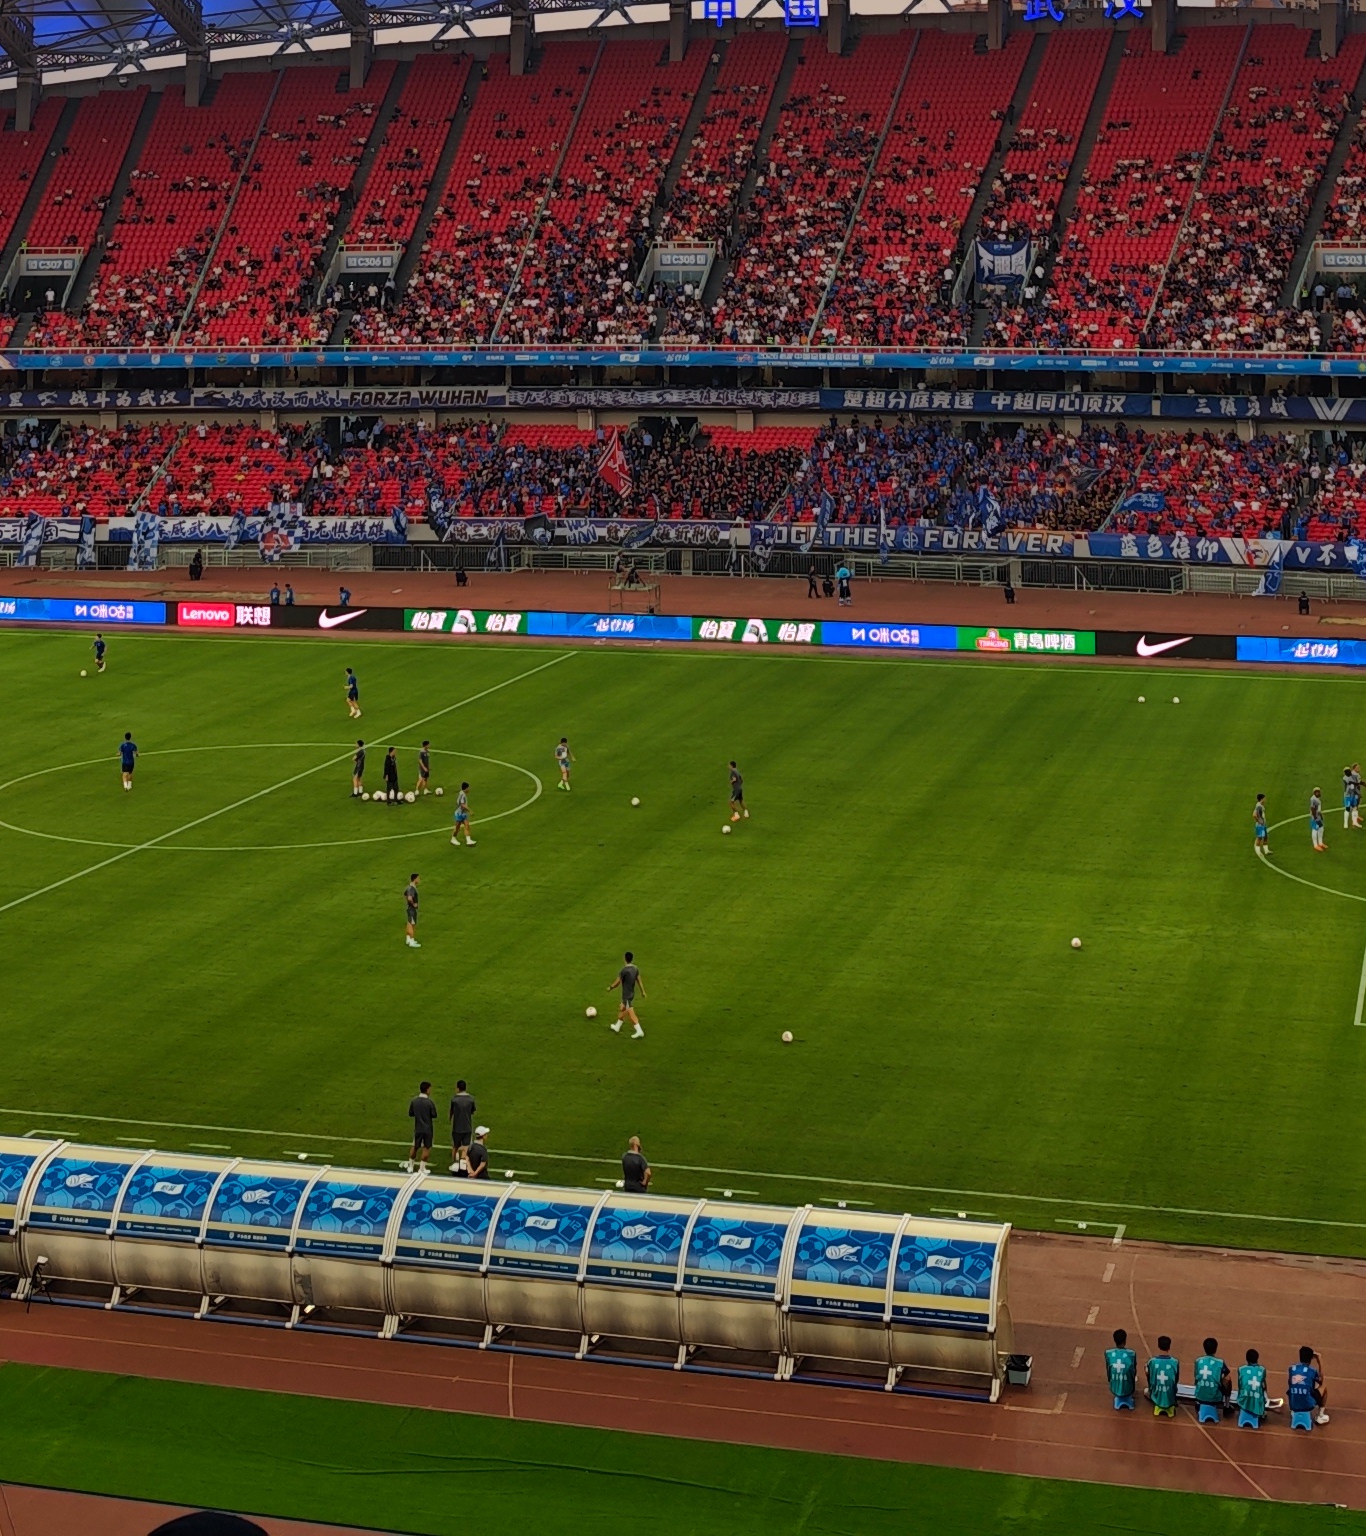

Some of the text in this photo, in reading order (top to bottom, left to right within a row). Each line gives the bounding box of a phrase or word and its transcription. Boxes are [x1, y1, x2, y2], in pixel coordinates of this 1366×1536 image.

[38, 259, 63, 269] C307
[69, 387, 182, 409] 战斗为武汉
[348, 390, 412, 407] FORZA
[418, 388, 490, 406] WUHAN
[990, 391, 1127, 415] 中超同心顶汉
[923, 529, 1066, 555] FOREVER
[1120, 532, 1219, 562] 蓝色信仰
[182, 607, 230, 621] Lenovo
[236, 605, 272, 625] 联想
[411, 611, 447, 631] 怡寶
[485, 613, 522, 632] 怡寶
[699, 620, 736, 641] 怡寶
[778, 622, 815, 642] 怡寶
[1013, 632, 1076, 651] 青岛啤酒
